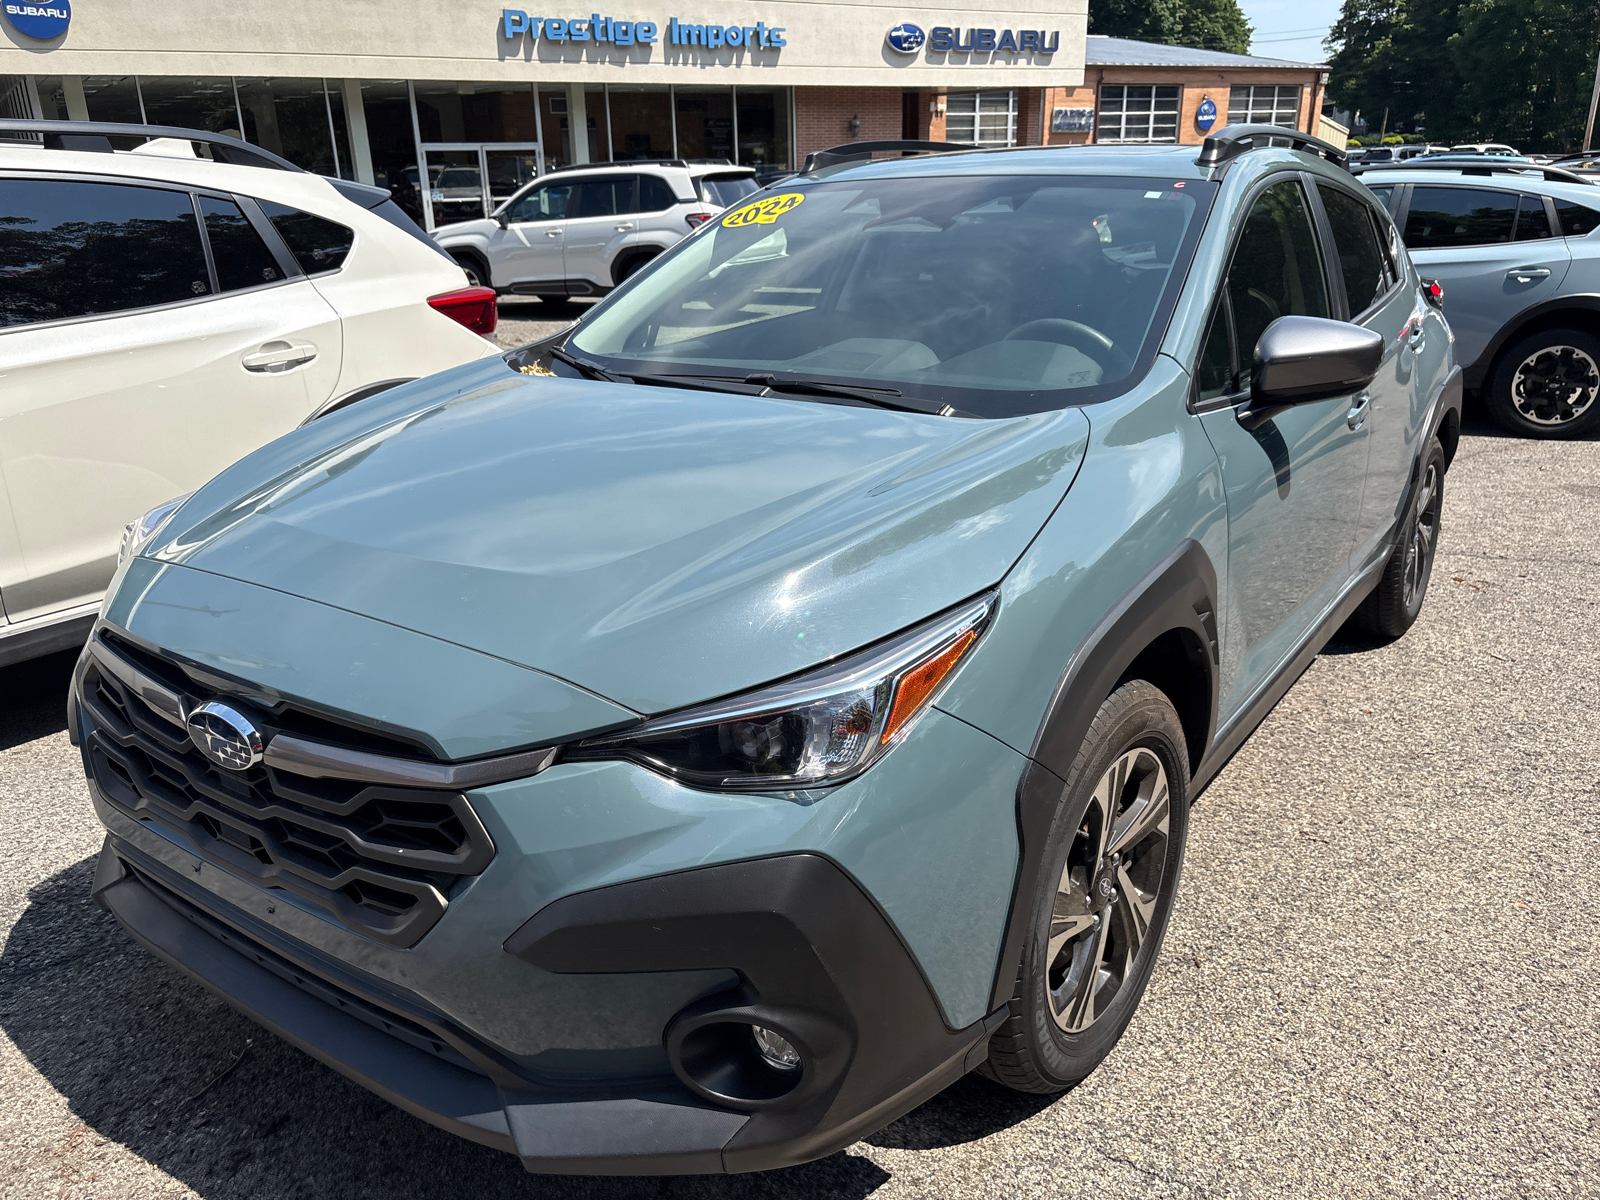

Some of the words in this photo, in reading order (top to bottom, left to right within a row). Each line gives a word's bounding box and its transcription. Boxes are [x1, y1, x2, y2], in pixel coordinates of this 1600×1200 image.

[6, 5, 67, 18] SUBARU
[502, 9, 658, 46] Prestige
[670, 17, 787, 48] Imports
[931, 26, 1059, 52] SUBARU
[727, 196, 800, 225] 2024
